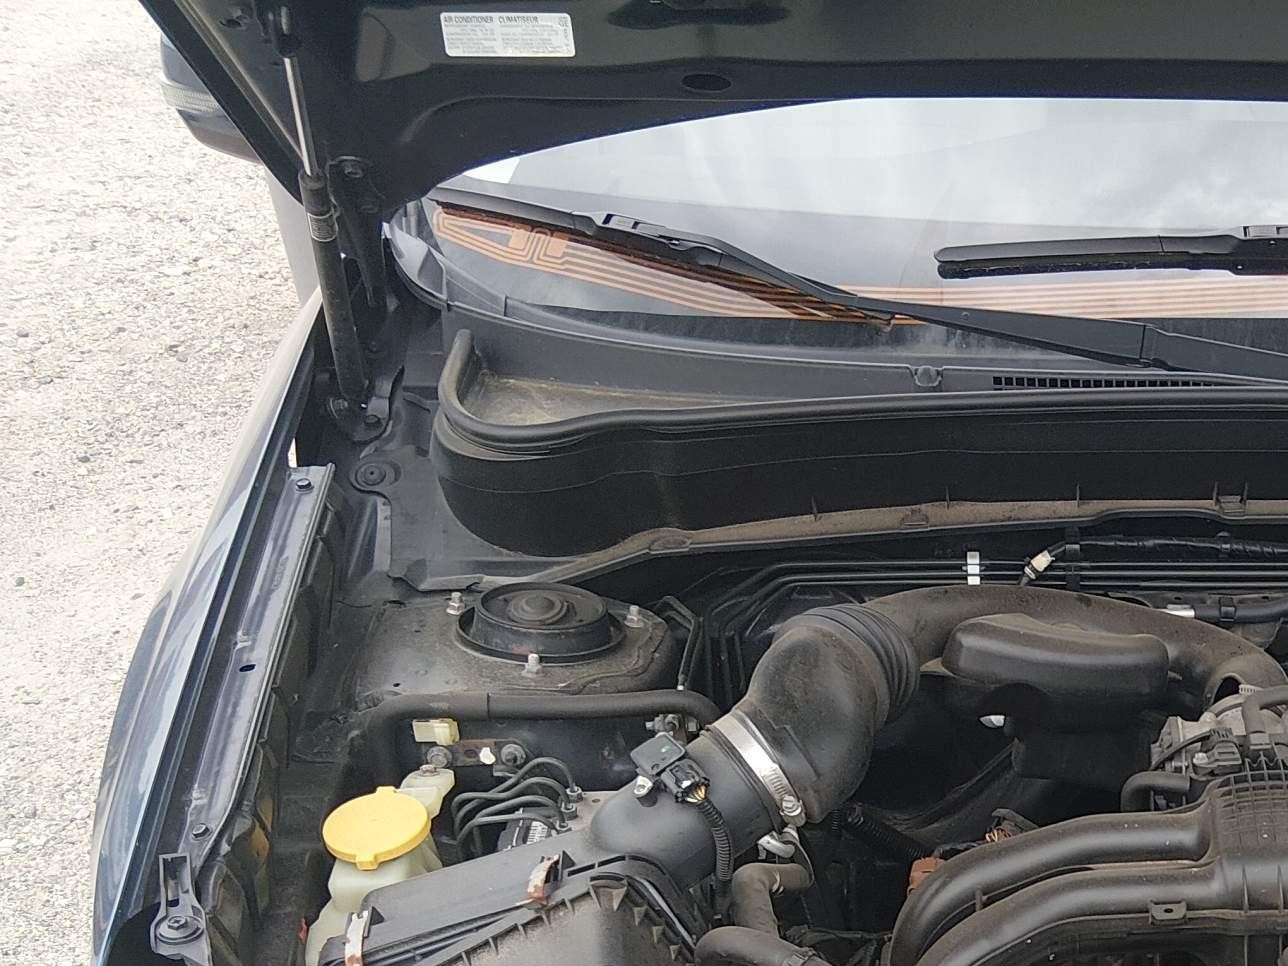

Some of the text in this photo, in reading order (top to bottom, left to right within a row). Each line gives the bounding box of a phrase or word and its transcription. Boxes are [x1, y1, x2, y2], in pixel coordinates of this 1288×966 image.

[444, 15, 494, 24] AIR CONDITIONER
[498, 15, 539, 24] CLIMATISEUR
